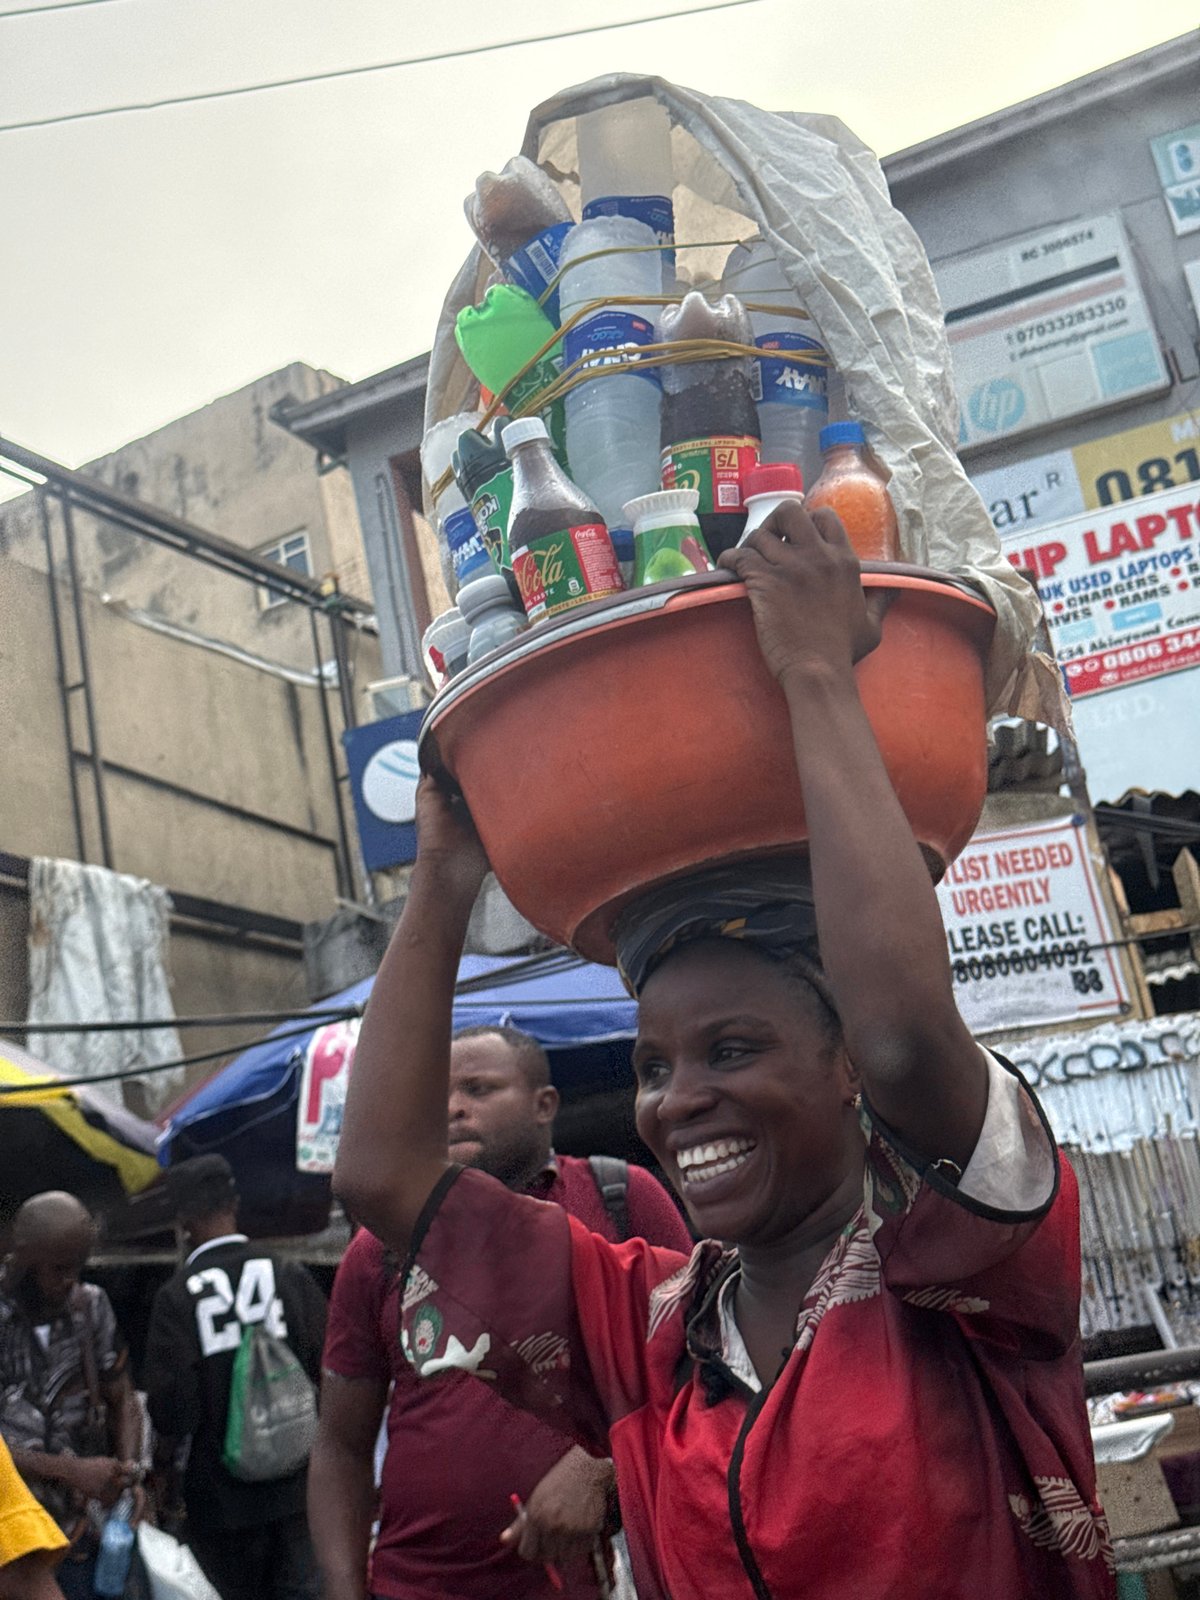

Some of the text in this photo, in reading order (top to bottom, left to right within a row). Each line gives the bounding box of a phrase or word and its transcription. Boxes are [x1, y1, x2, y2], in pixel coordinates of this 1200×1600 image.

[717, 450, 738, 468] 75
[1007, 502, 1200, 582] IP LAPT
[1067, 574, 1159, 607] CHARGERS
[1069, 571, 1113, 595] USED
[1118, 546, 1193, 581] LAPTOPS
[995, 843, 1073, 876] NEEDED
[952, 876, 1050, 916] URGENTLY
[948, 911, 1086, 953] LEASE CALL:
[186, 1258, 287, 1356] 24
